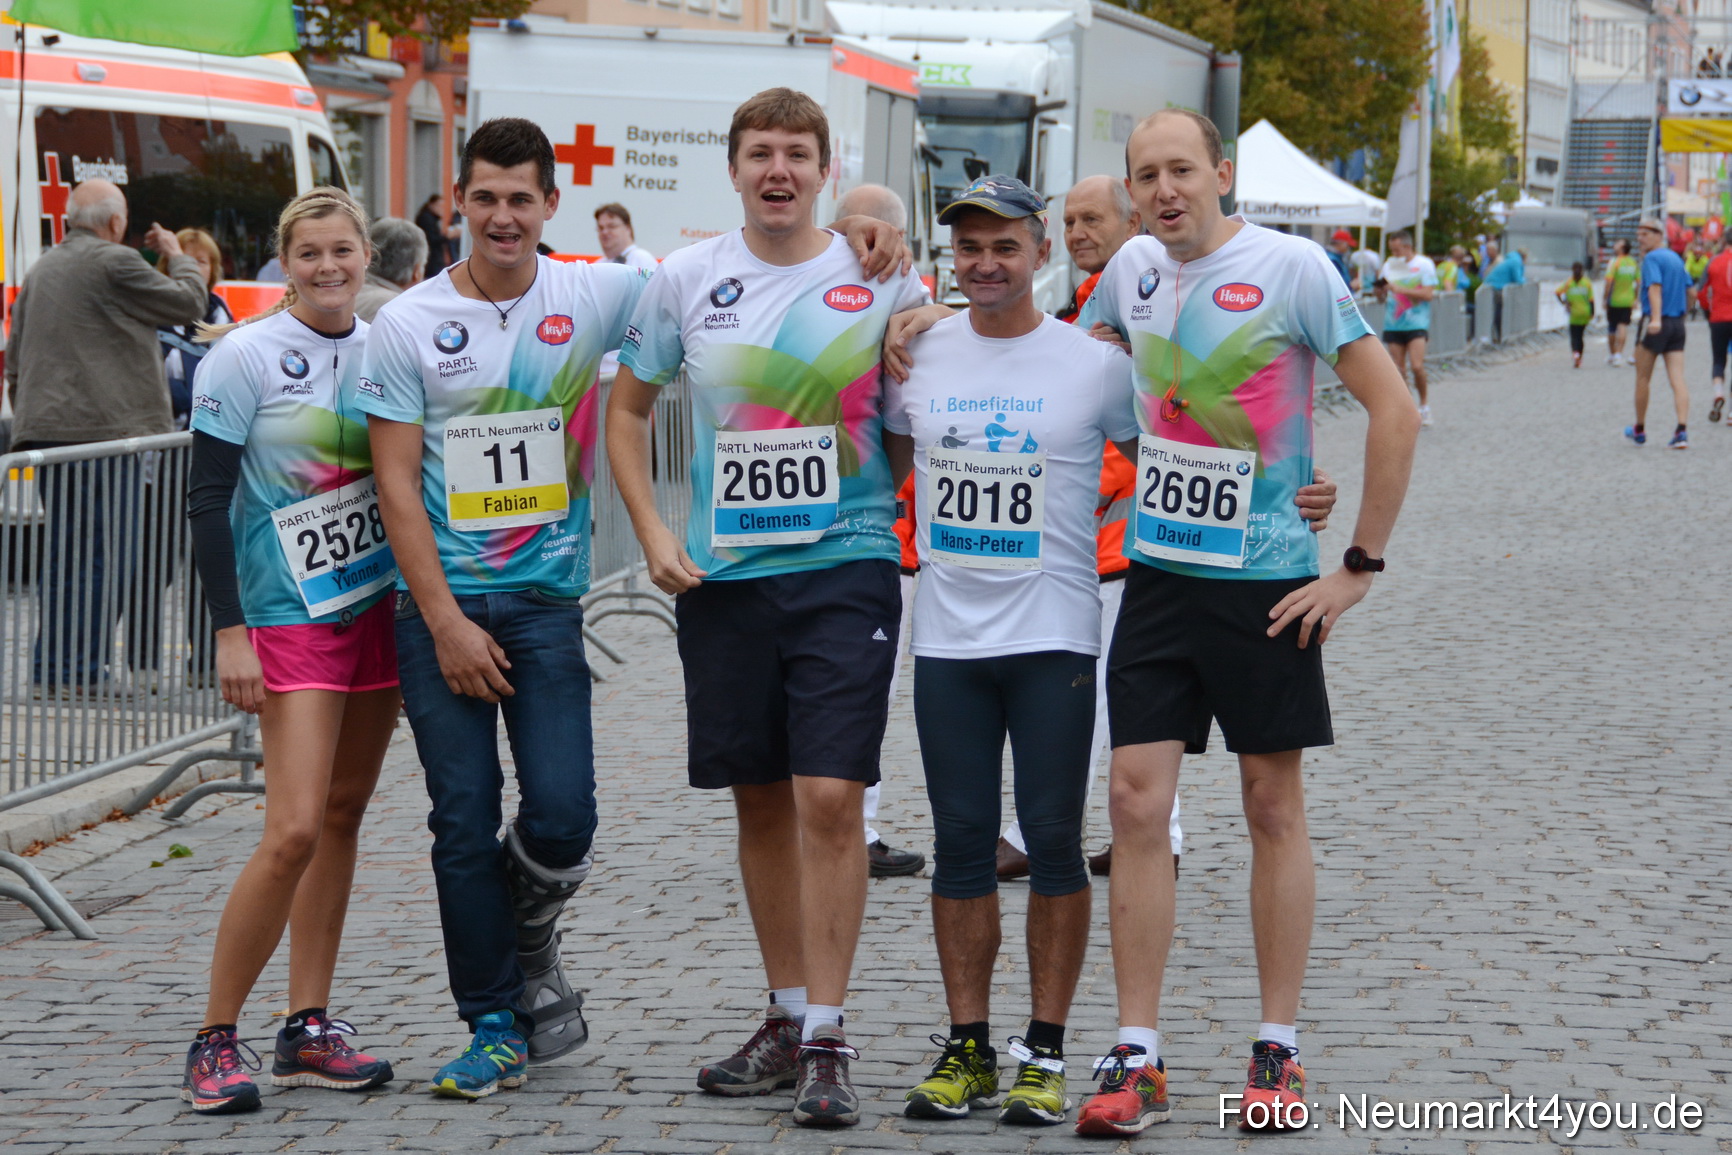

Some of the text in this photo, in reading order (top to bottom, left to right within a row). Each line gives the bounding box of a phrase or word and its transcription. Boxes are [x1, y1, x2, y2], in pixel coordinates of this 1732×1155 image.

[625, 149, 679, 167] Rotes
[624, 173, 678, 191] Kreuz
[1243, 201, 1320, 218] Laufsport
[830, 291, 869, 305] Hervis
[1219, 288, 1258, 305] Hervis
[704, 313, 740, 323] PARTL
[1131, 305, 1153, 314] PARTL
[704, 322, 740, 330] Neumarkt
[438, 356, 477, 371] PARTL
[440, 365, 478, 378] Neumarkt
[930, 396, 1044, 413] 1. Benefizlauf
[447, 422, 544, 440] PARTL Neumarkt
[717, 439, 813, 454] PARTL Neumarkt
[483, 440, 529, 484] 11
[930, 457, 1023, 476] PARTL Neumarkt
[1141, 446, 1231, 473] PARTL Neumarkt
[723, 455, 827, 502] 2660
[937, 476, 1032, 525] 2018
[1142, 465, 1239, 521] 2696
[278, 490, 371, 531] PARTL Neumarkt
[483, 494, 538, 513] Fabian
[739, 513, 811, 530] Clemens
[297, 502, 387, 571] 2528
[941, 530, 1024, 553] Hans-Peter
[1156, 524, 1202, 547] David
[331, 561, 379, 590] Yvonne
